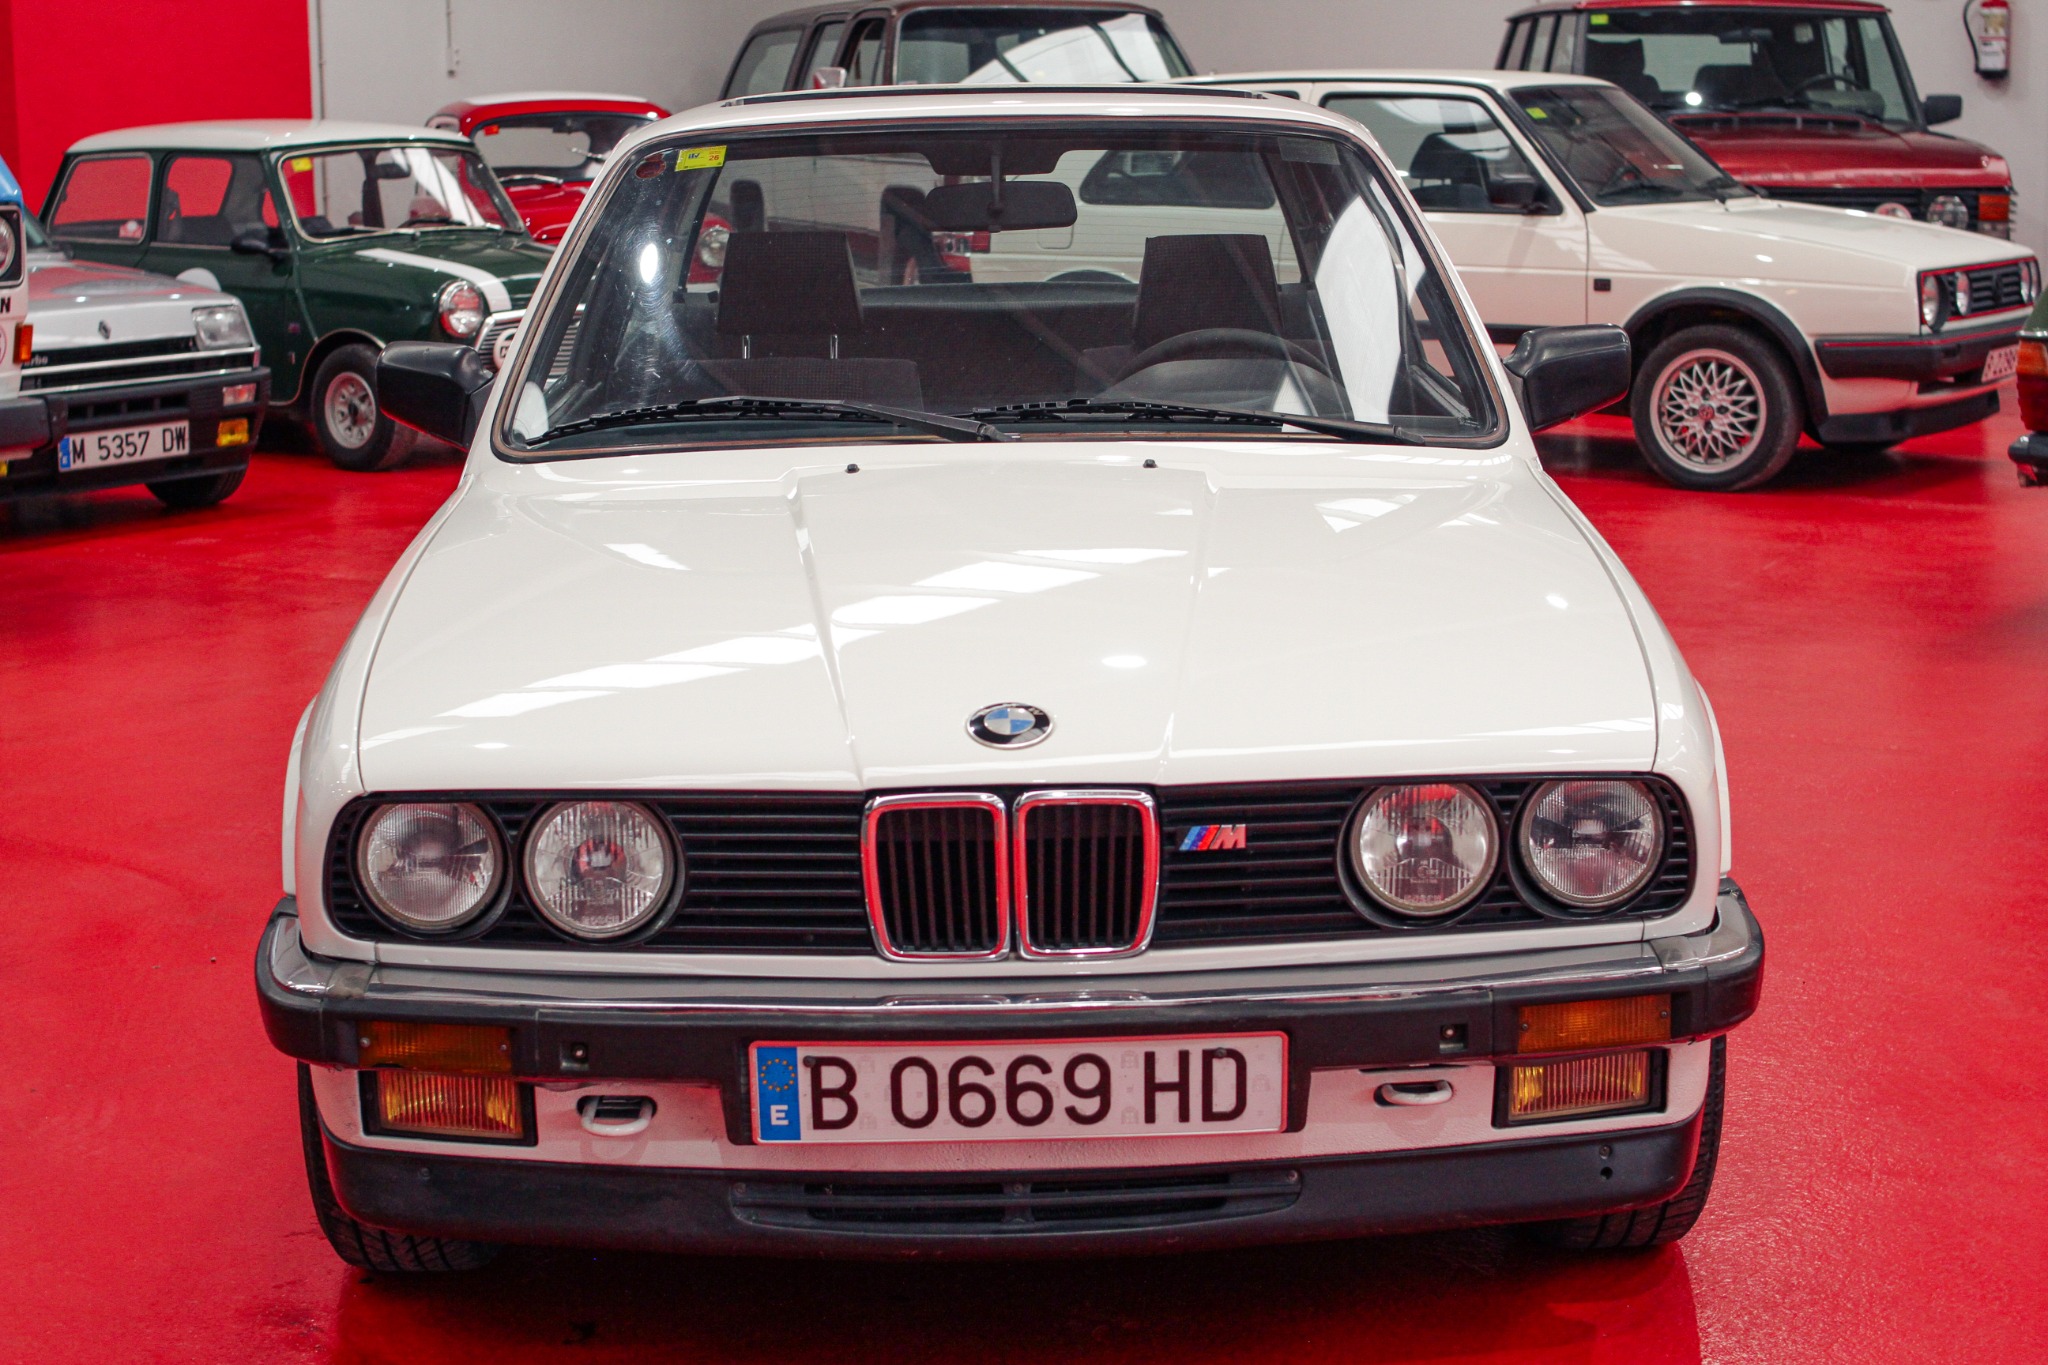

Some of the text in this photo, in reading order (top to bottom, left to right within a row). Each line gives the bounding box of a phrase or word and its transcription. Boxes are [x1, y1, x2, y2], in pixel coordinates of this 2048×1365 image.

[72, 426, 186, 464] M 5357 DW
[810, 1048, 1247, 1130] B 0669 HD
[770, 1104, 789, 1126] E
